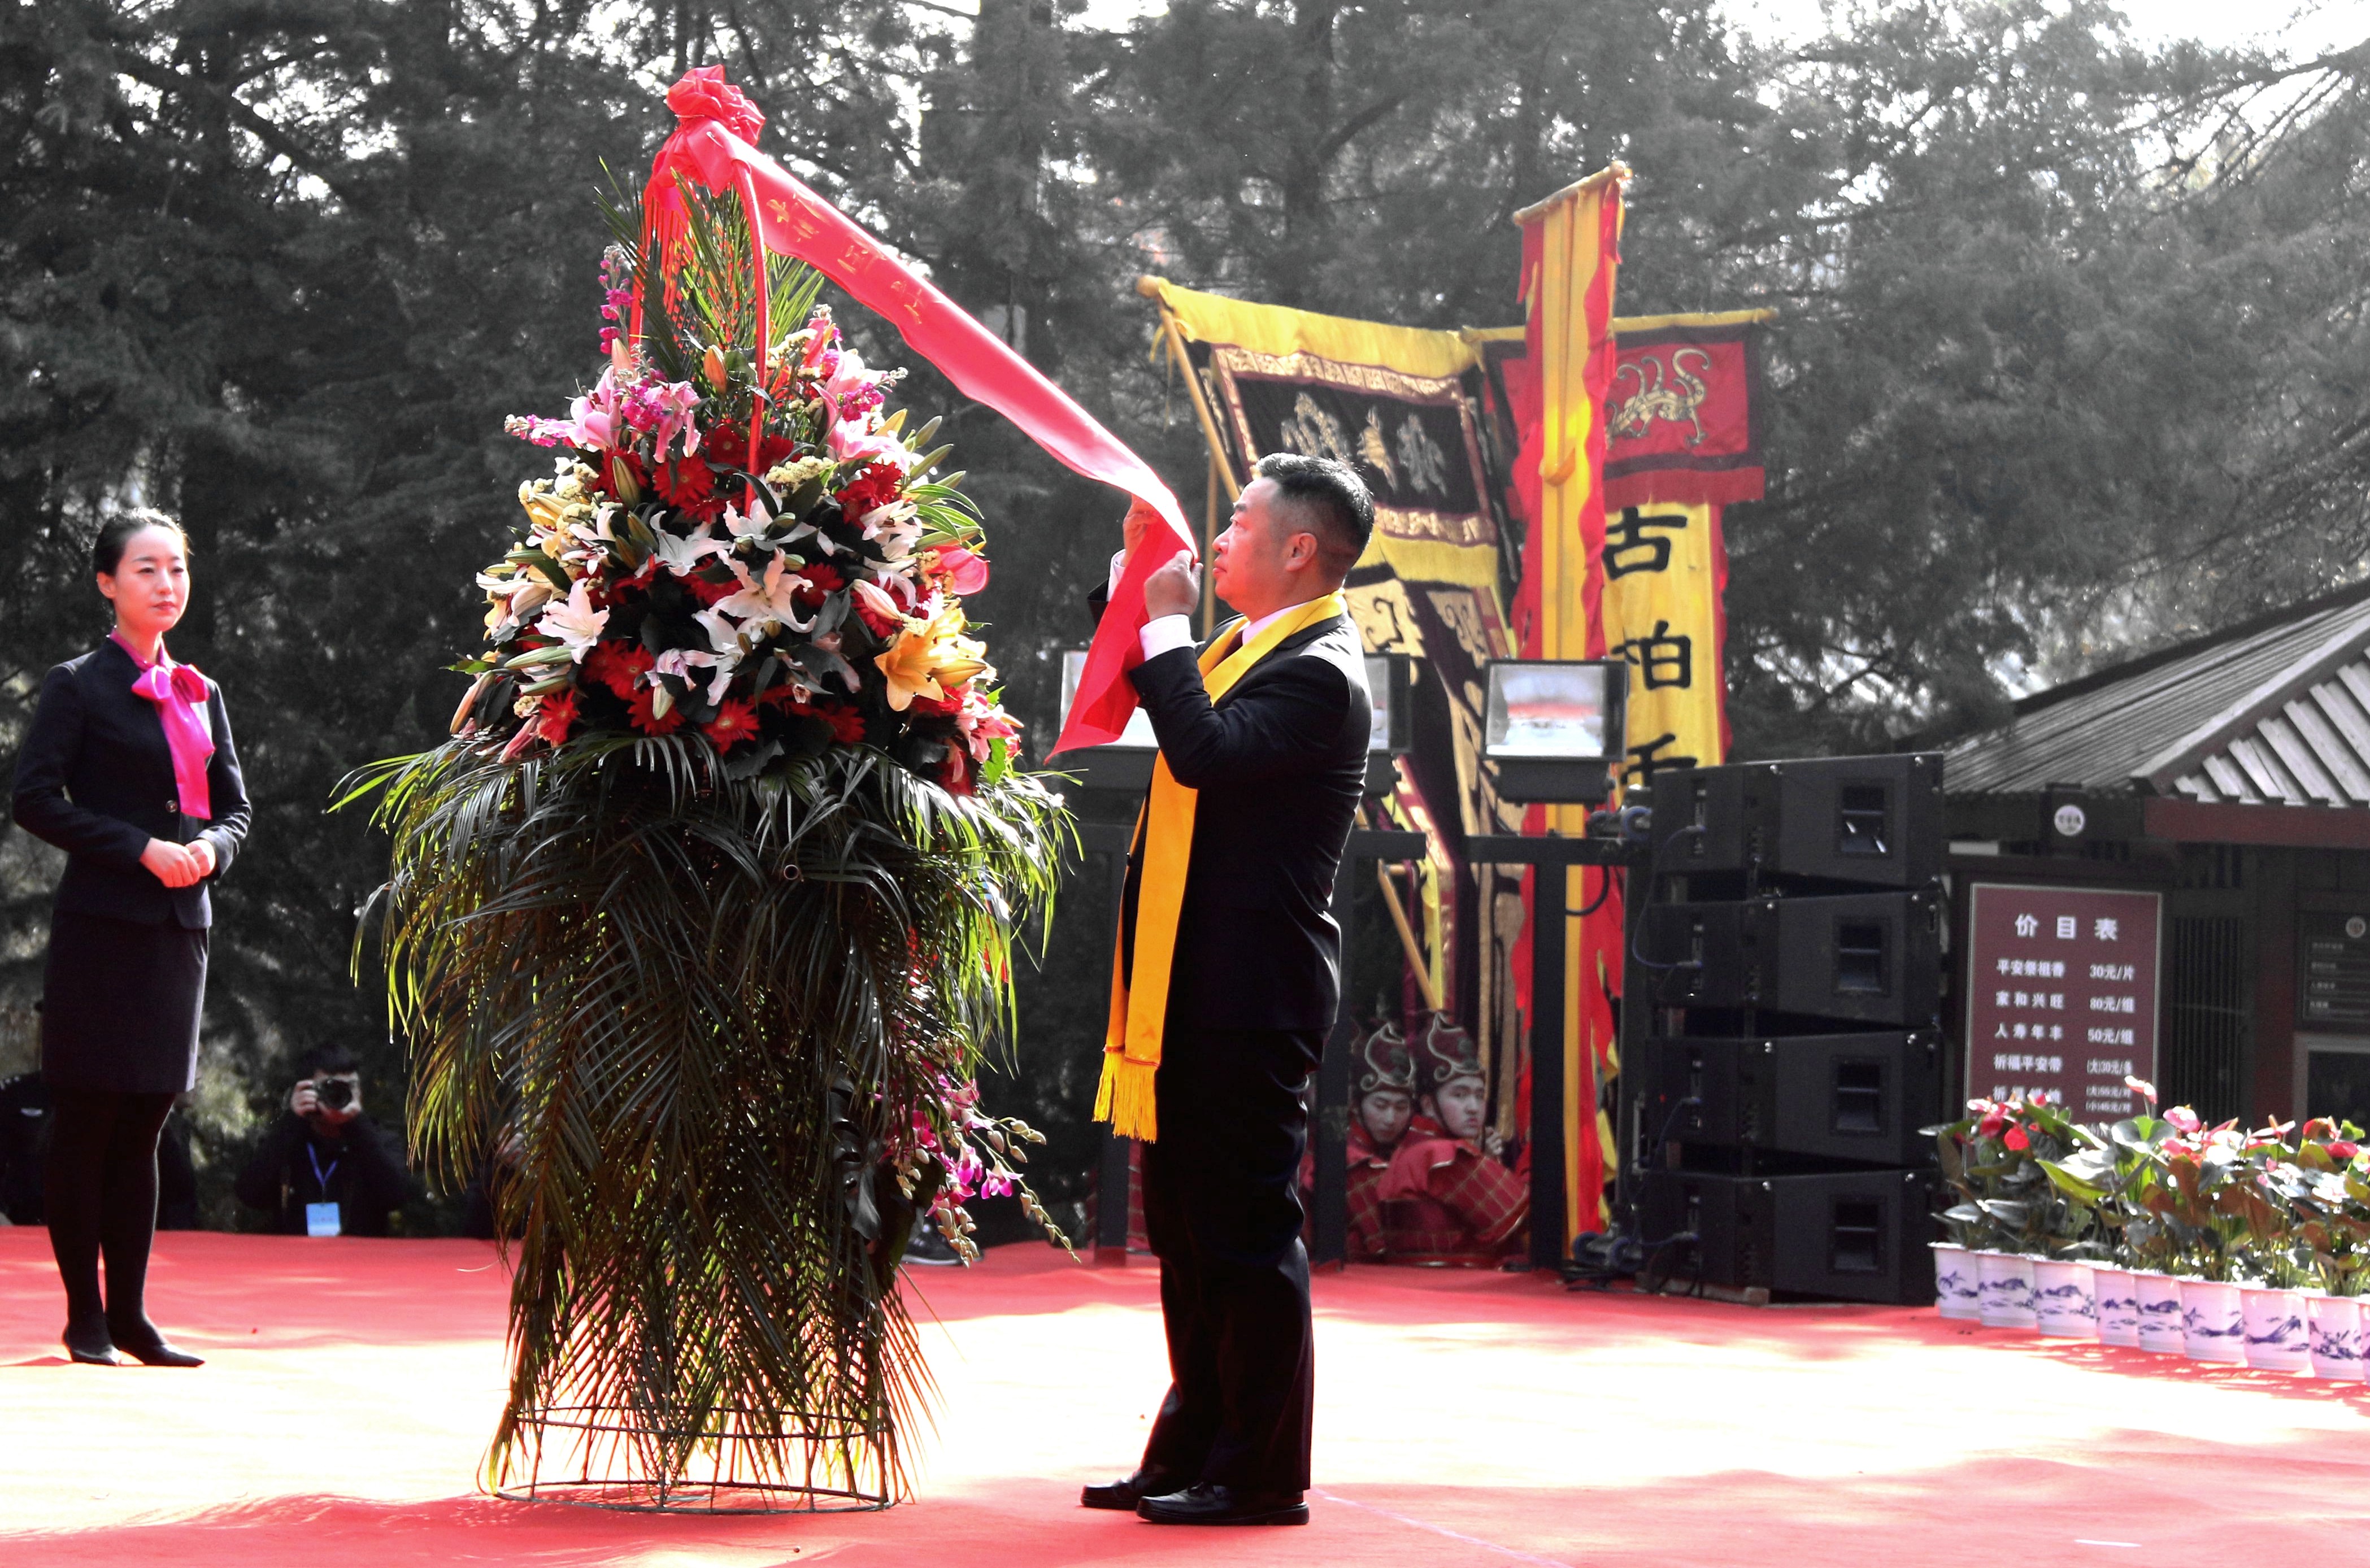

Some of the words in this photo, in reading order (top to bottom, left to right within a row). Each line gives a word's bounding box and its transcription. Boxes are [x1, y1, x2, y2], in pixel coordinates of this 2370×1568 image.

[2015, 913, 2118, 941] 价目表
[1995, 991, 2064, 1010] 家和兴旺
[2090, 997, 2136, 1014] 80元/组
[1994, 1022, 2063, 1040] 人寿年丰
[2088, 1028, 2135, 1046] 50元/组
